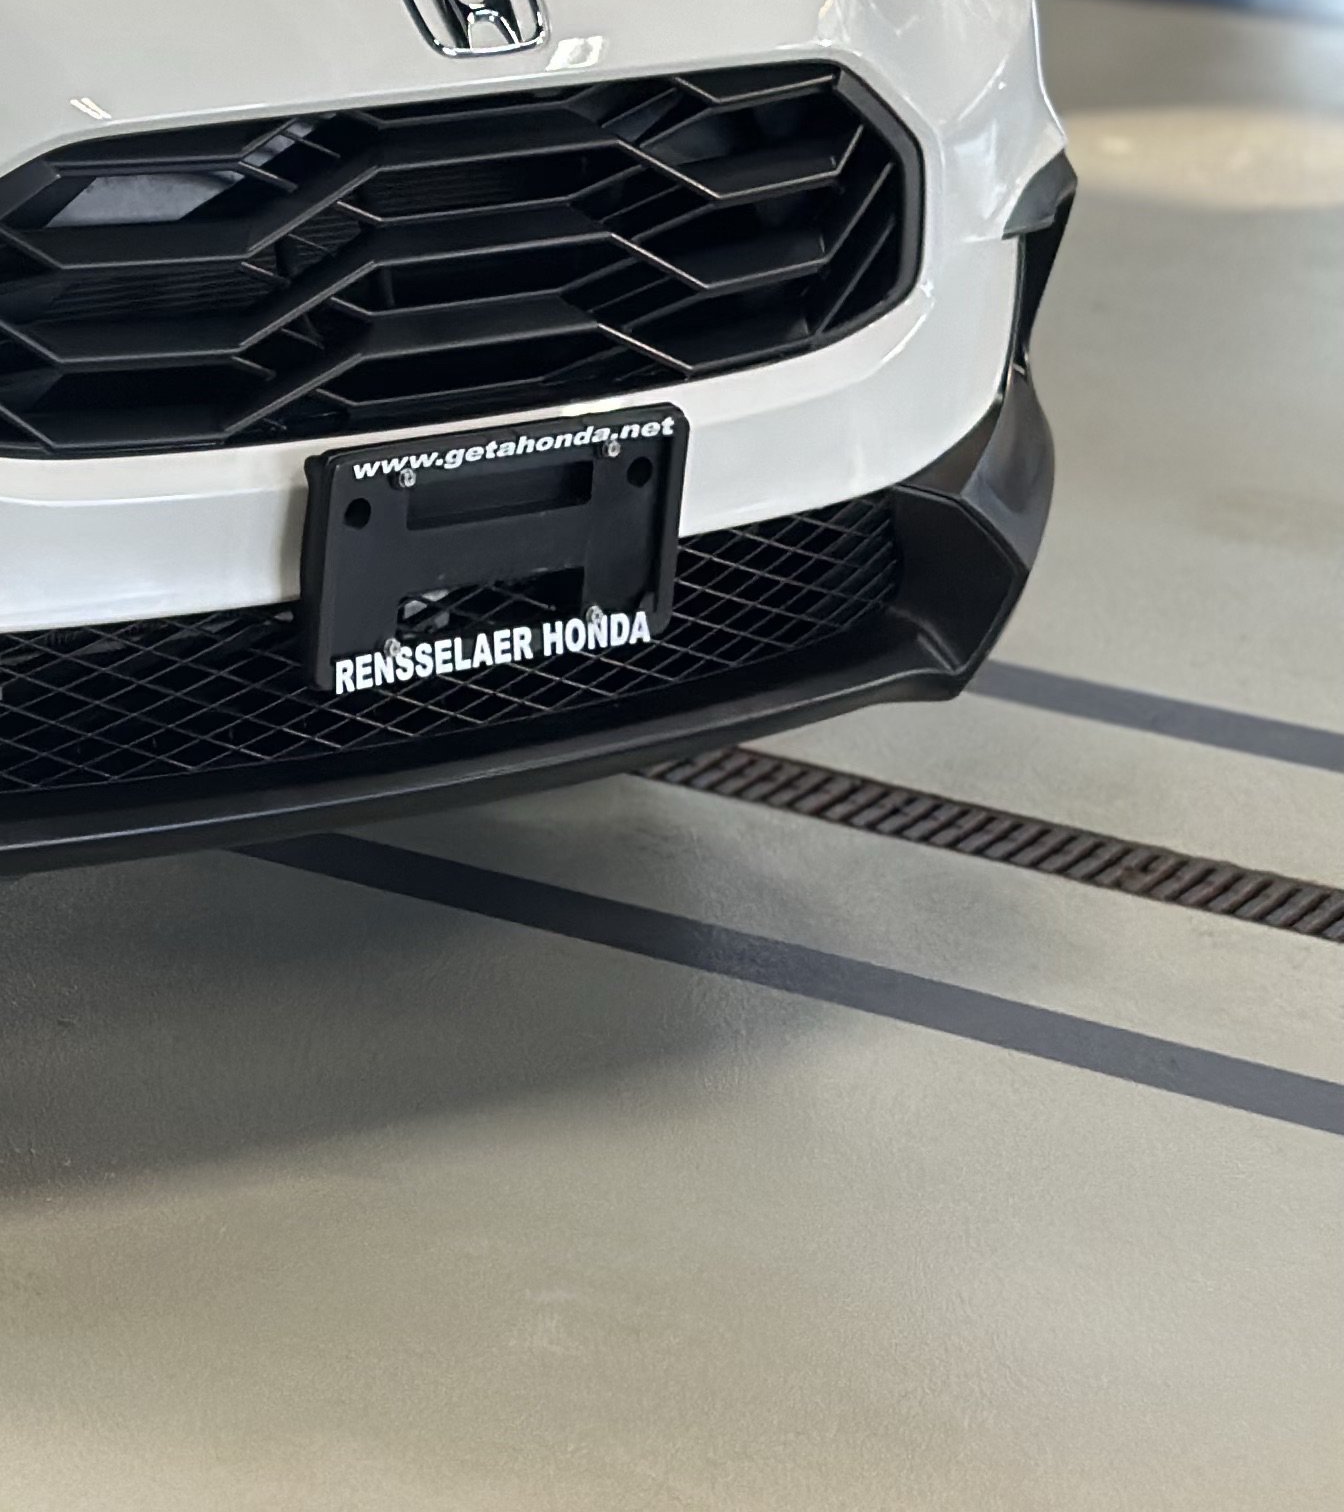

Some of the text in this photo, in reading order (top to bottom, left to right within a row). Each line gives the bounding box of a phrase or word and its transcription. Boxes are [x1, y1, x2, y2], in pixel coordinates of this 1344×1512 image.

[352, 415, 676, 480] www.getahonda.net
[335, 611, 651, 694] RENSSELAER HONDA
